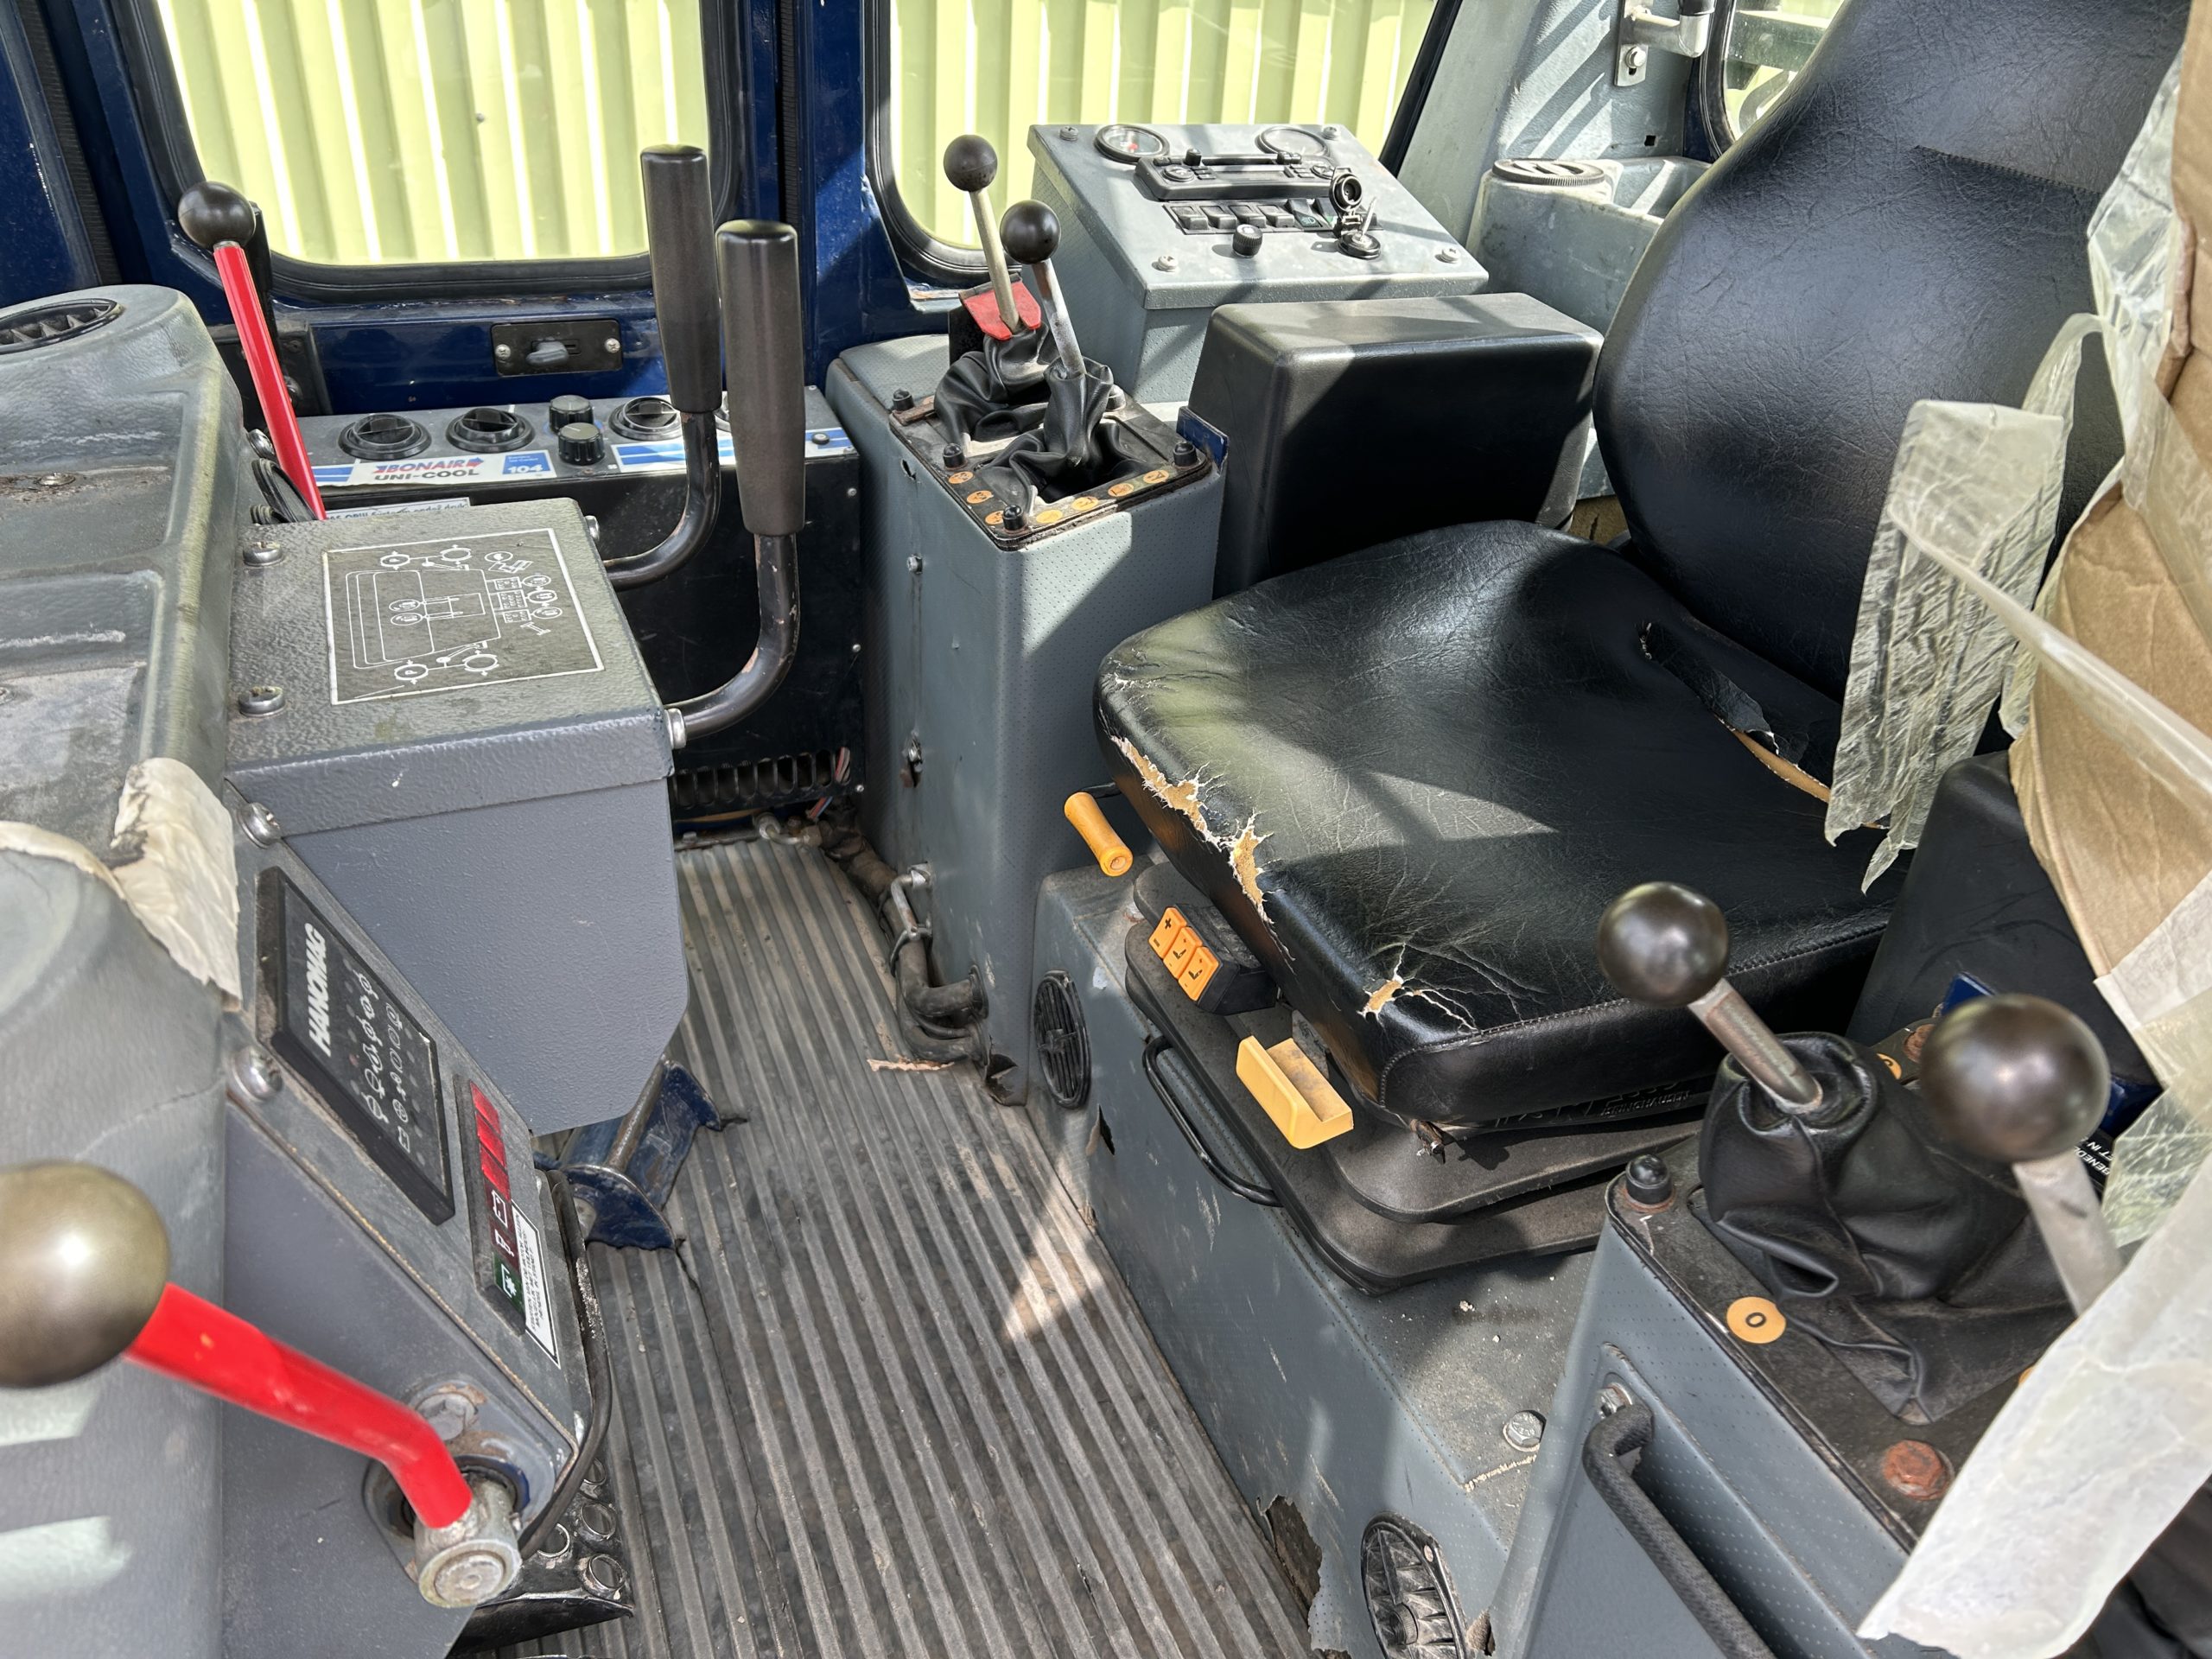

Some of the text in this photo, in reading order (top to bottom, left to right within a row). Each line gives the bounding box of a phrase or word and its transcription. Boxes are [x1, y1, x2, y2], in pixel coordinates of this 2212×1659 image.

[385, 459, 466, 474] BONAIR
[507, 464, 543, 474] 104
[374, 469, 480, 480] UNI-COOL
[305, 923, 331, 1058] HANOMAG
